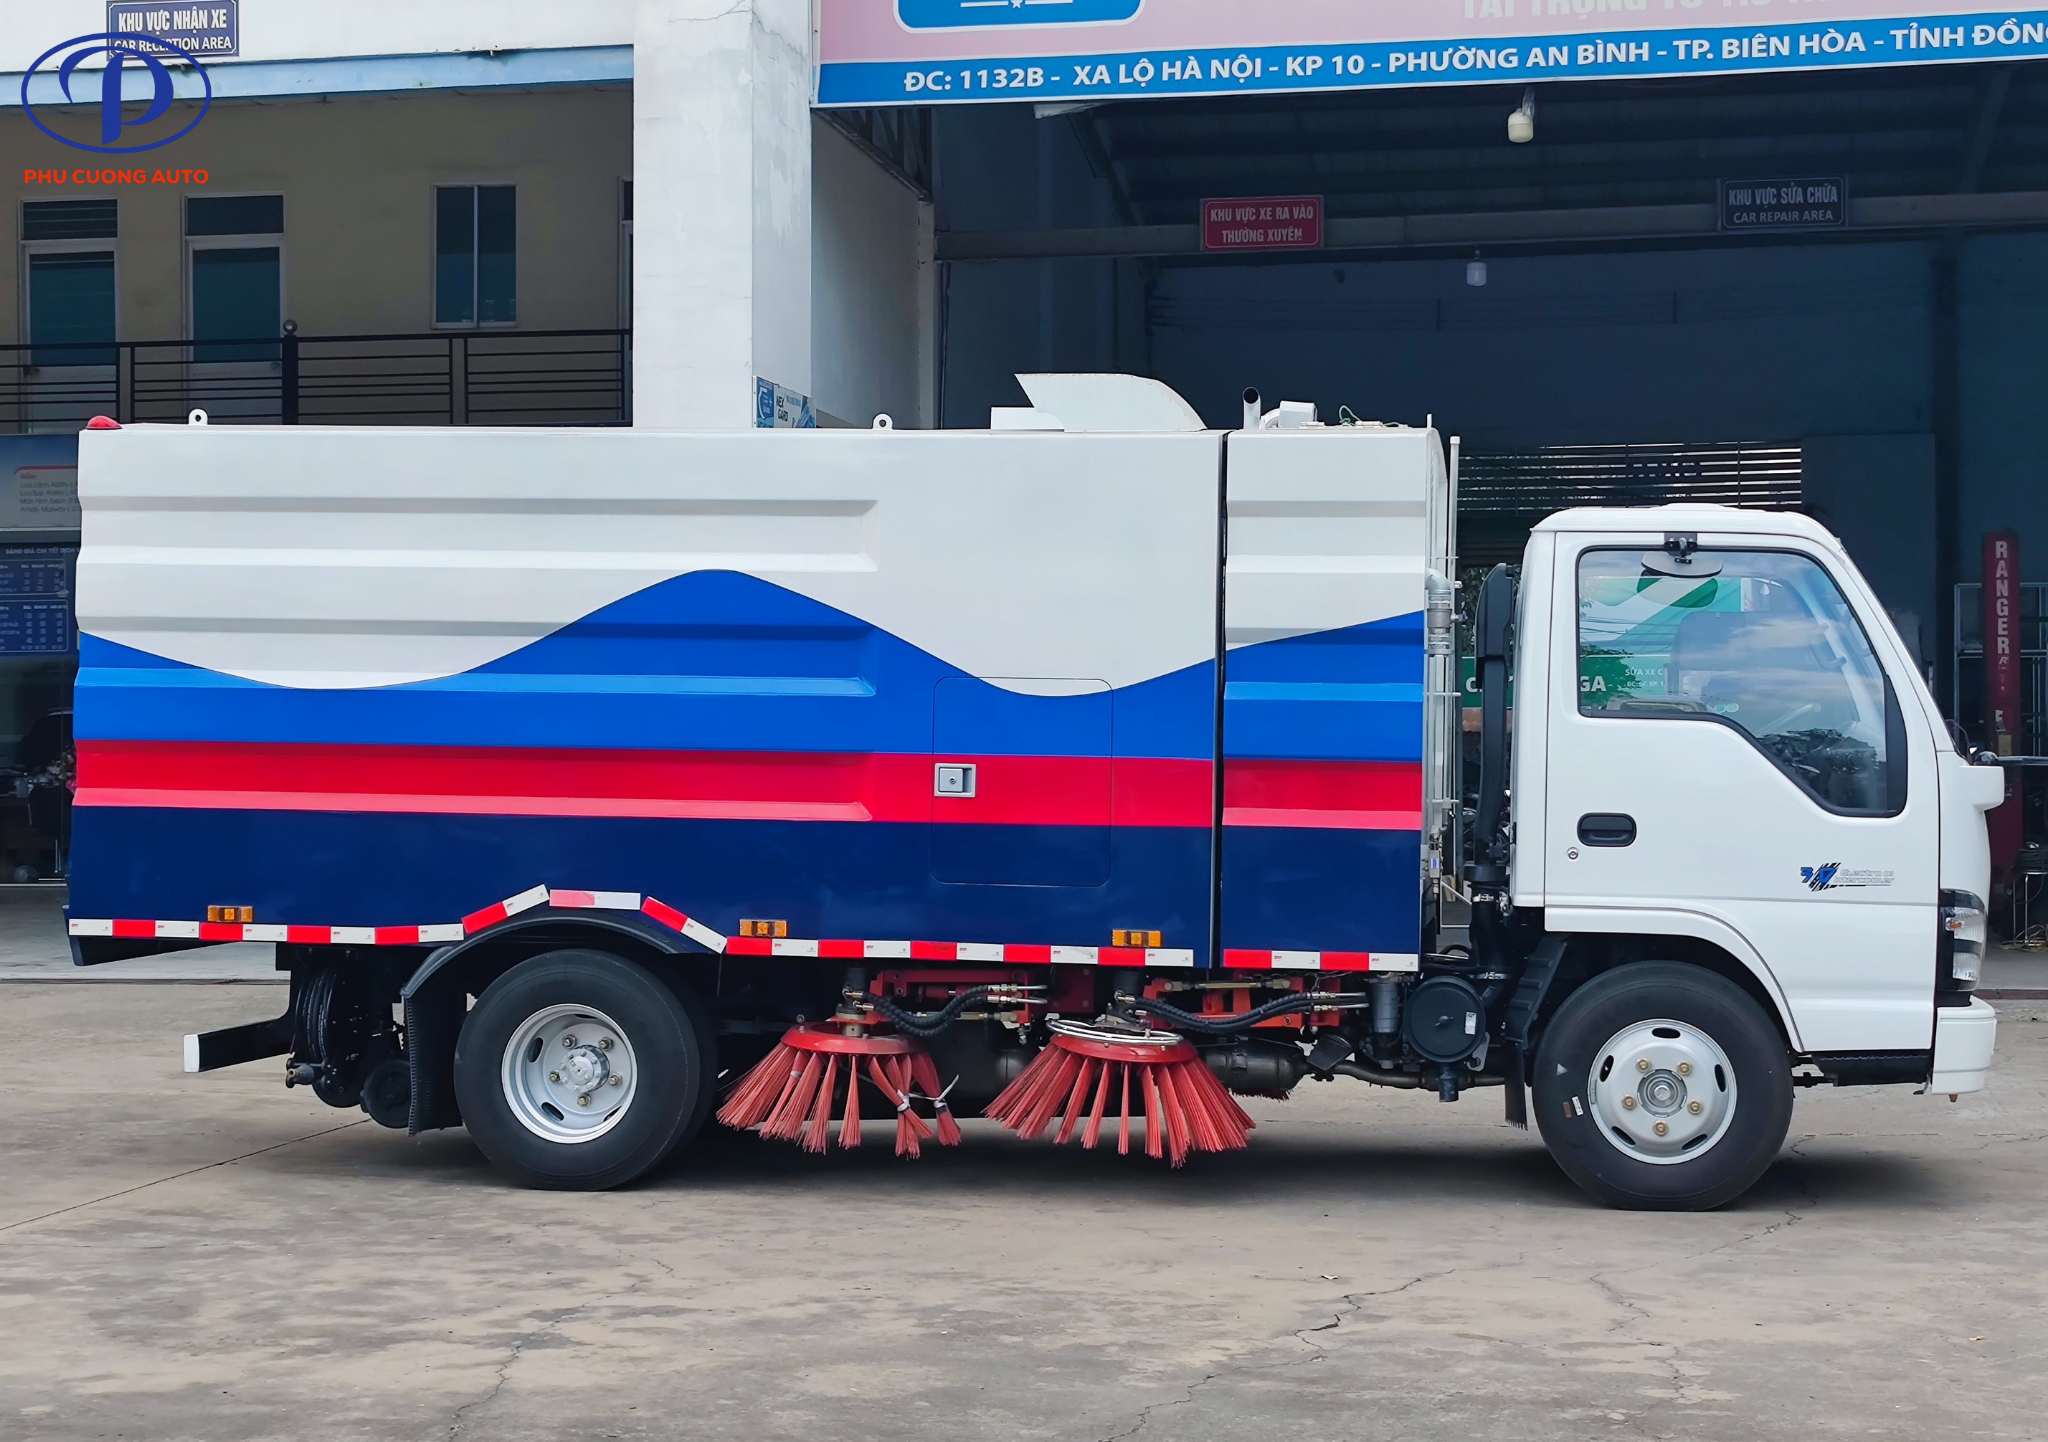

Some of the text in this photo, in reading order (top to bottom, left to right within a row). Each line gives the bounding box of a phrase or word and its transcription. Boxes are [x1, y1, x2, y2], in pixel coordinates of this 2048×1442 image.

[118, 6, 227, 35] KHU VỰC NHẬN XE
[202, 36, 232, 49] AREA
[904, 71, 952, 92] ĐC:
[960, 67, 1044, 89] 1132B
[1072, 65, 1112, 86] XA
[1118, 58, 1155, 88] LỘ
[1161, 56, 1203, 81] HÀ
[1210, 54, 1262, 84] NỘI
[1286, 55, 1323, 76] KP
[1331, 54, 1365, 75] 10
[1388, 46, 1518, 73] PHƯỜNG
[1525, 46, 1569, 68] AN
[1577, 39, 1649, 66] BÌNH
[1672, 39, 1714, 60] TP.
[1721, 33, 1790, 59] BIÊN
[1799, 28, 1866, 55] HÒA
[1890, 22, 1964, 50] TỈNH
[1972, 18, 2048, 46] ĐỒN
[1729, 181, 1838, 208] KHU VỰC SỬA CHỮA
[1210, 203, 1314, 224] KHU VỰC XE RA VÀO
[1733, 209, 1834, 224] CAR REPAIR AREA
[1222, 225, 1303, 243] THƯỜNG XUYÊN
[1995, 540, 2010, 655] RANGER
[1645, 668, 1656, 676] XE
